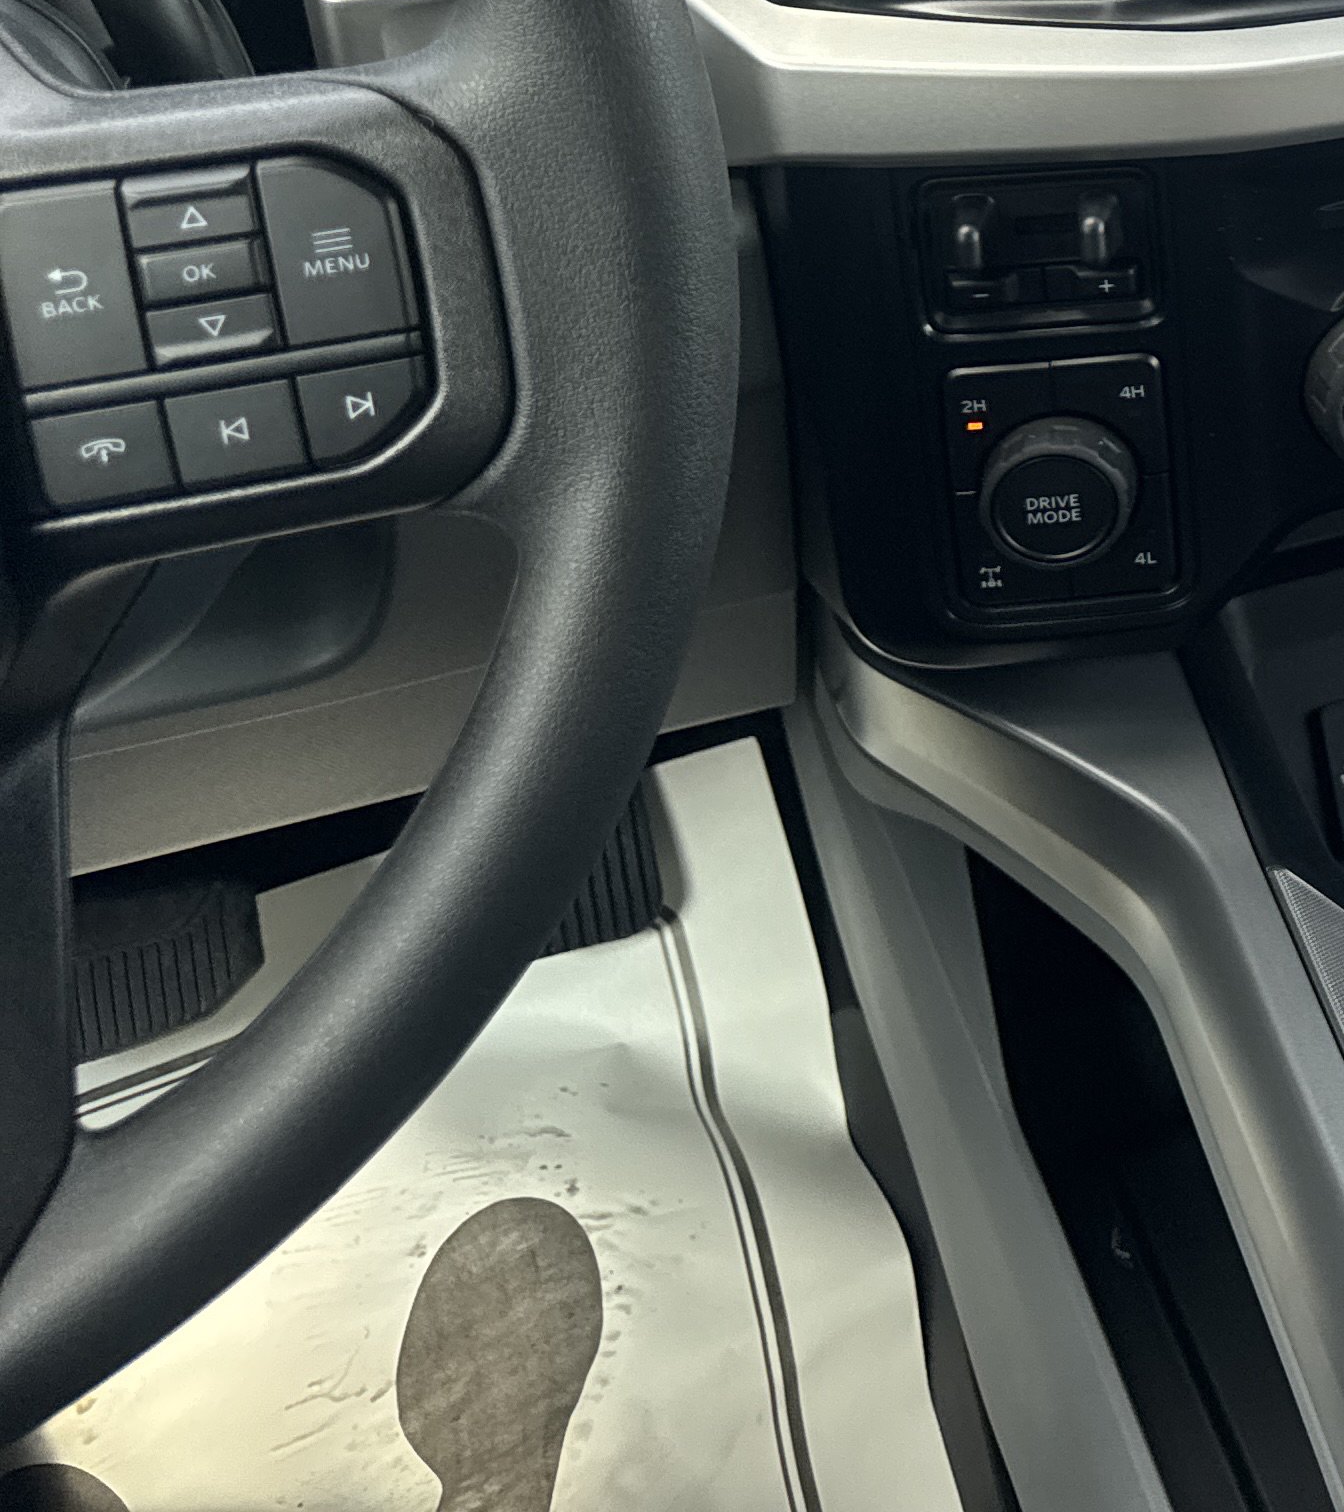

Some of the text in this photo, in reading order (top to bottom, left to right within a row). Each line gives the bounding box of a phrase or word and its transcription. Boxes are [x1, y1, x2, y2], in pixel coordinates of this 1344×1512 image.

[182, 263, 217, 283] OK
[303, 252, 371, 278] MENU
[41, 295, 104, 319] BACK
[1119, 385, 1146, 399] 4H
[961, 399, 987, 414] 2H
[1025, 493, 1081, 511] DRIVE
[1027, 508, 1083, 525] MODE
[1134, 551, 1157, 565] 4L
